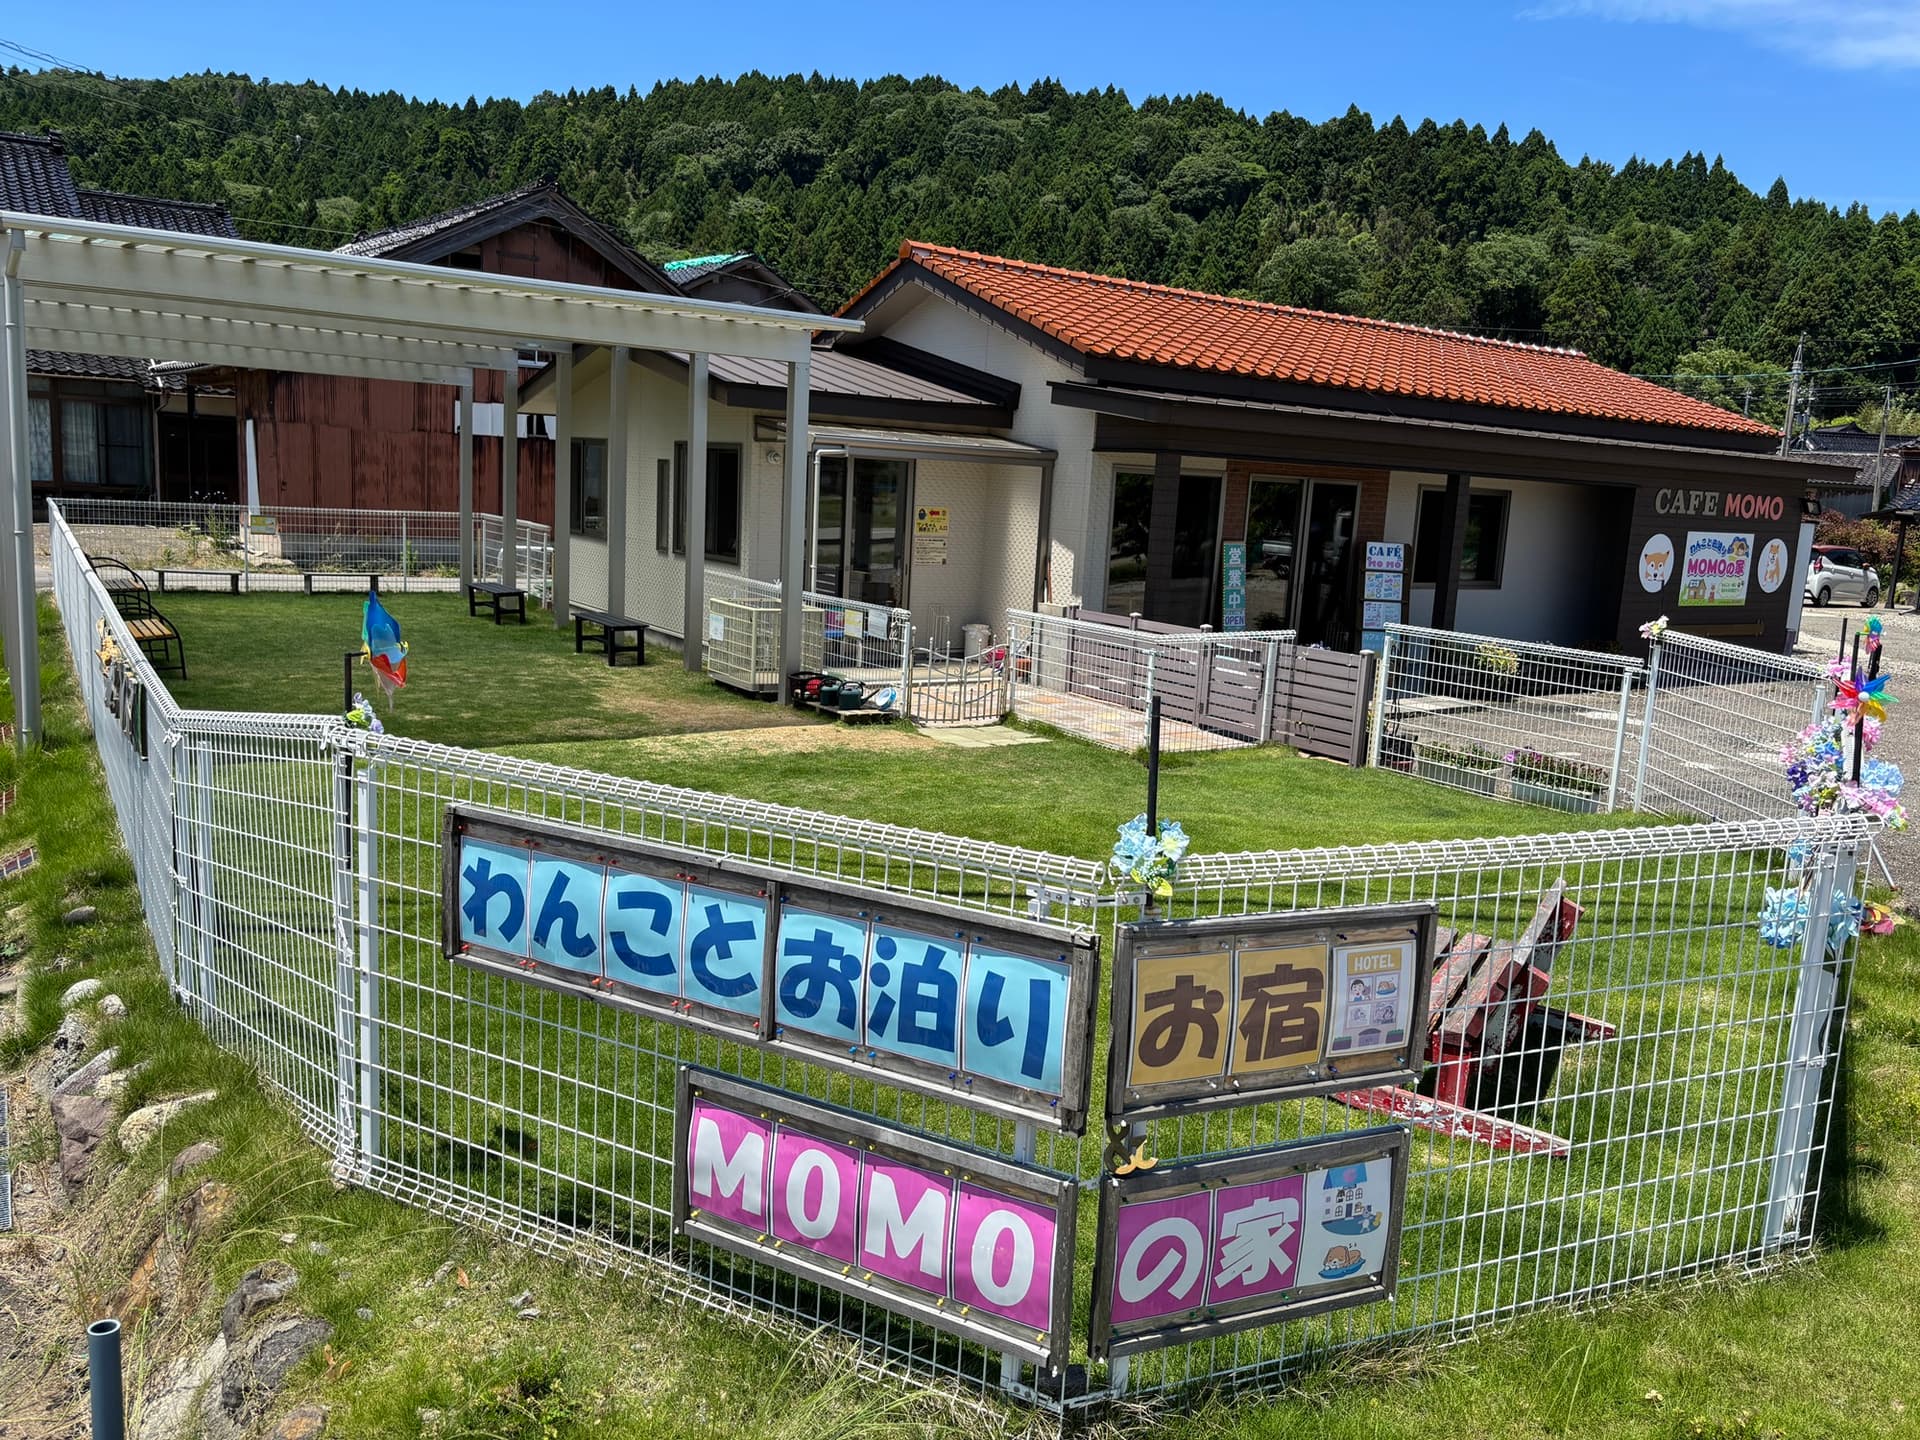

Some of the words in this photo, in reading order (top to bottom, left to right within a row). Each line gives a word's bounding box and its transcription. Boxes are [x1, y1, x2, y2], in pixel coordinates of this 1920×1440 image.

[1655, 488, 1720, 516] CAFE
[1724, 493, 1784, 521] MOMO
[1228, 547, 1242, 609] 営業中
[1225, 615, 1244, 625] OPEN
[462, 857, 1051, 1079] わんことお泊り
[1354, 953, 1394, 972] HOTEL
[1138, 963, 1325, 1068] お宿
[692, 1116, 1035, 1307] MOMO
[1118, 1196, 1300, 1304] の家
